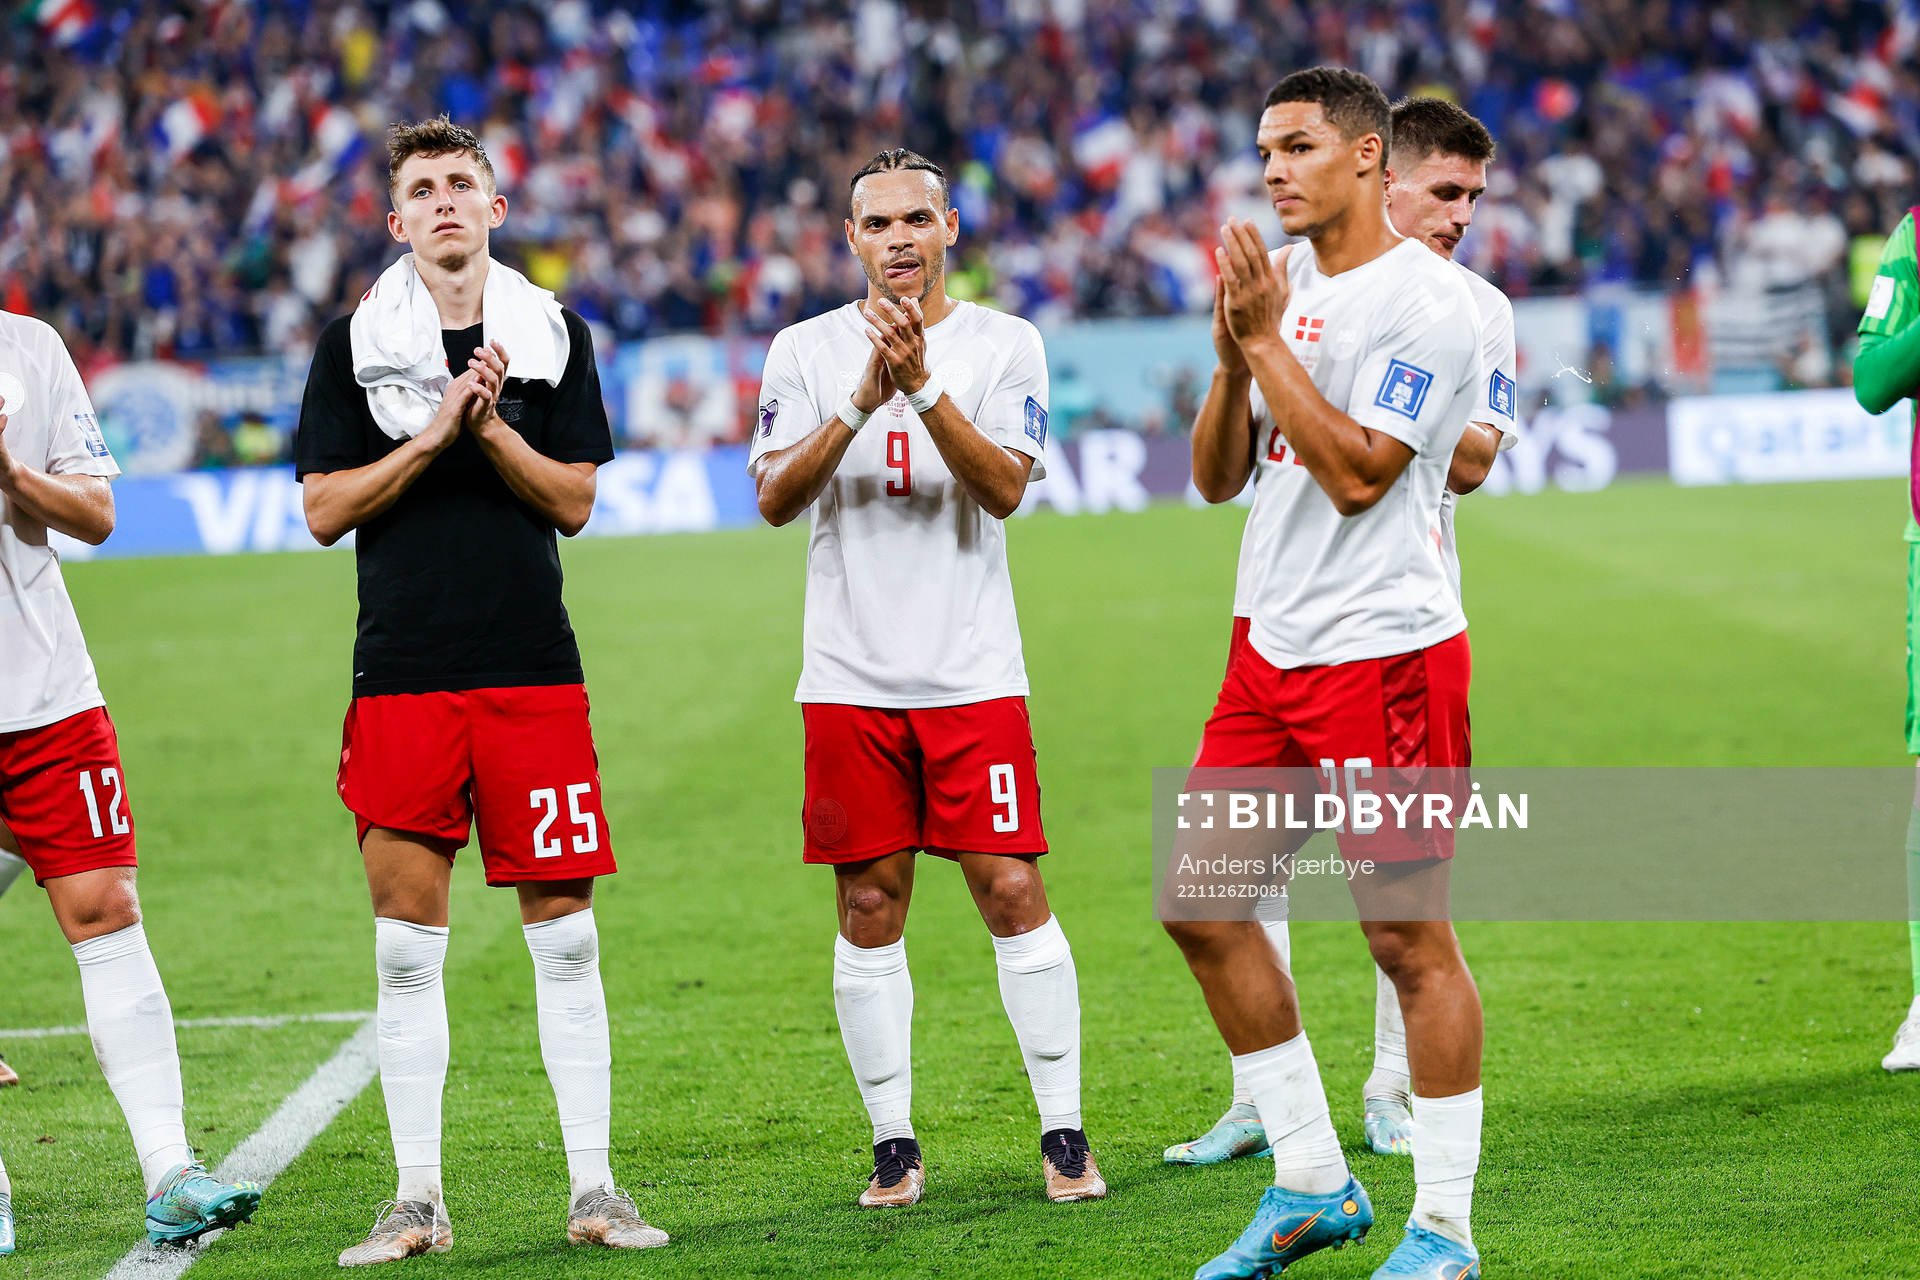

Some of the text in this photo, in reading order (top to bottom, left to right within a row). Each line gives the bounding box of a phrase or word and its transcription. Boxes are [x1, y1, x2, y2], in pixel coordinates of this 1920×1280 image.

[590, 450, 720, 534] SA
[886, 431, 911, 497] 9
[79, 767, 132, 838] 12
[529, 782, 599, 859] 25
[988, 763, 1019, 833] 9
